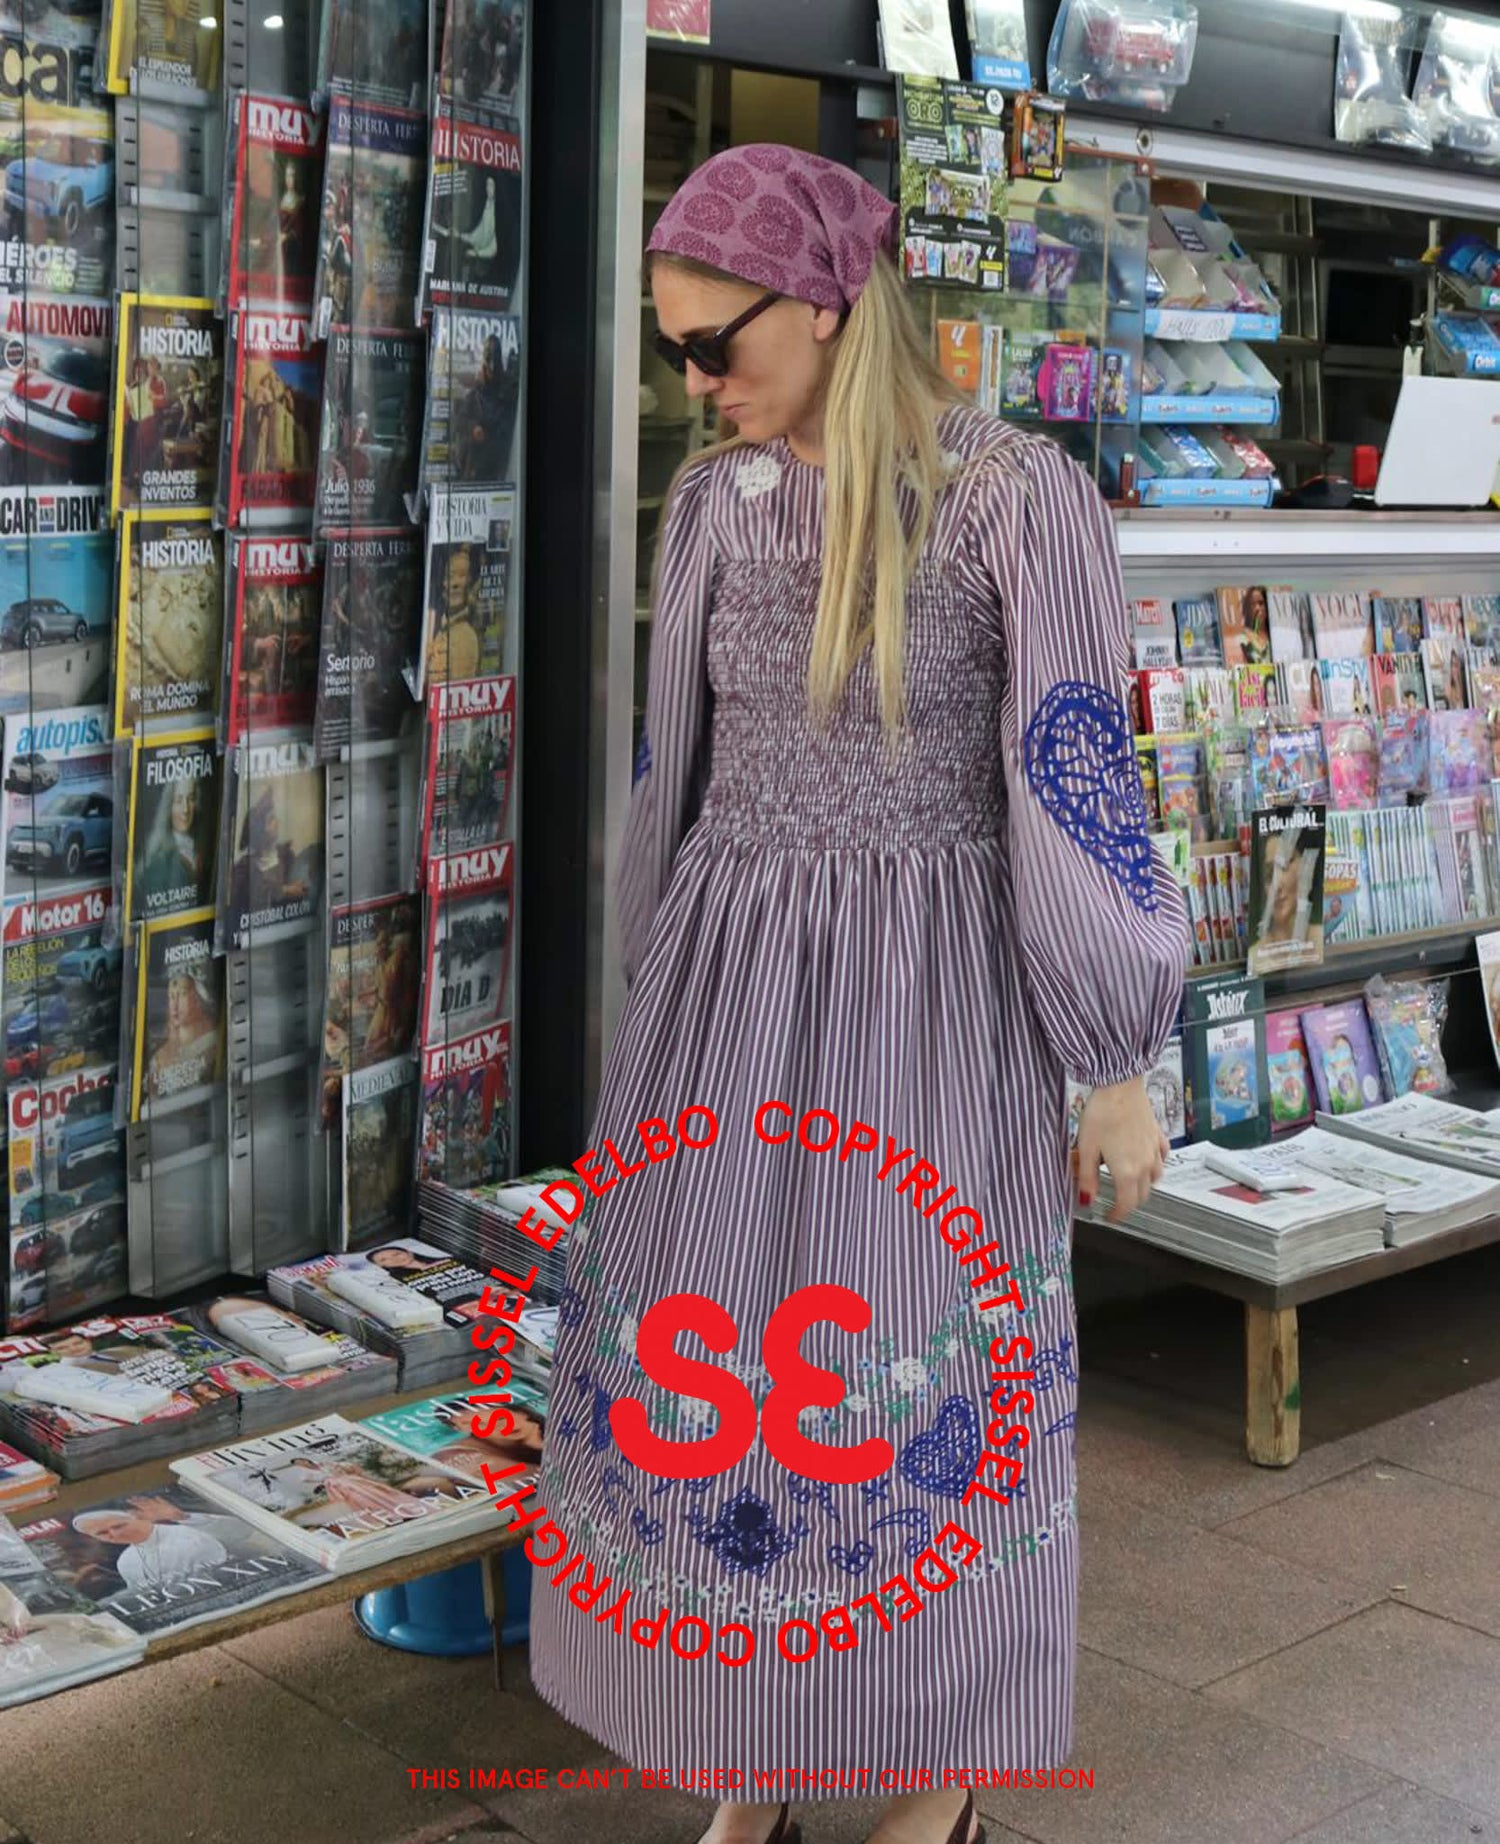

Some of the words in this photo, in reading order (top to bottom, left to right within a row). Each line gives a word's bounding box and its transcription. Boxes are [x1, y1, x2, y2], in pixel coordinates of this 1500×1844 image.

[248, 100, 321, 146] muy
[438, 129, 521, 171] HISTORIA
[140, 326, 213, 356] HISTORIA
[245, 316, 314, 350] muy
[439, 314, 519, 355] HISTORIA
[143, 469, 198, 485] GRANDES
[142, 485, 197, 501] INVENTOS
[436, 496, 489, 520] HISTORIA
[1, 497, 39, 534] CAR
[142, 538, 215, 568] HISTORIA
[247, 542, 315, 569] muy
[327, 653, 376, 672] Sertorio
[157, 694, 198, 712] MUNDO
[440, 680, 512, 711] muy
[439, 846, 510, 883] muy
[146, 884, 199, 907] VOLTAIRE
[21, 901, 81, 935] Motor
[85, 893, 105, 921] 16
[165, 940, 210, 964] HISTORIA
[441, 977, 473, 1013] DÍA
[479, 976, 490, 1001] D
[431, 1029, 500, 1072] muy
[213, 1424, 338, 1465] living
